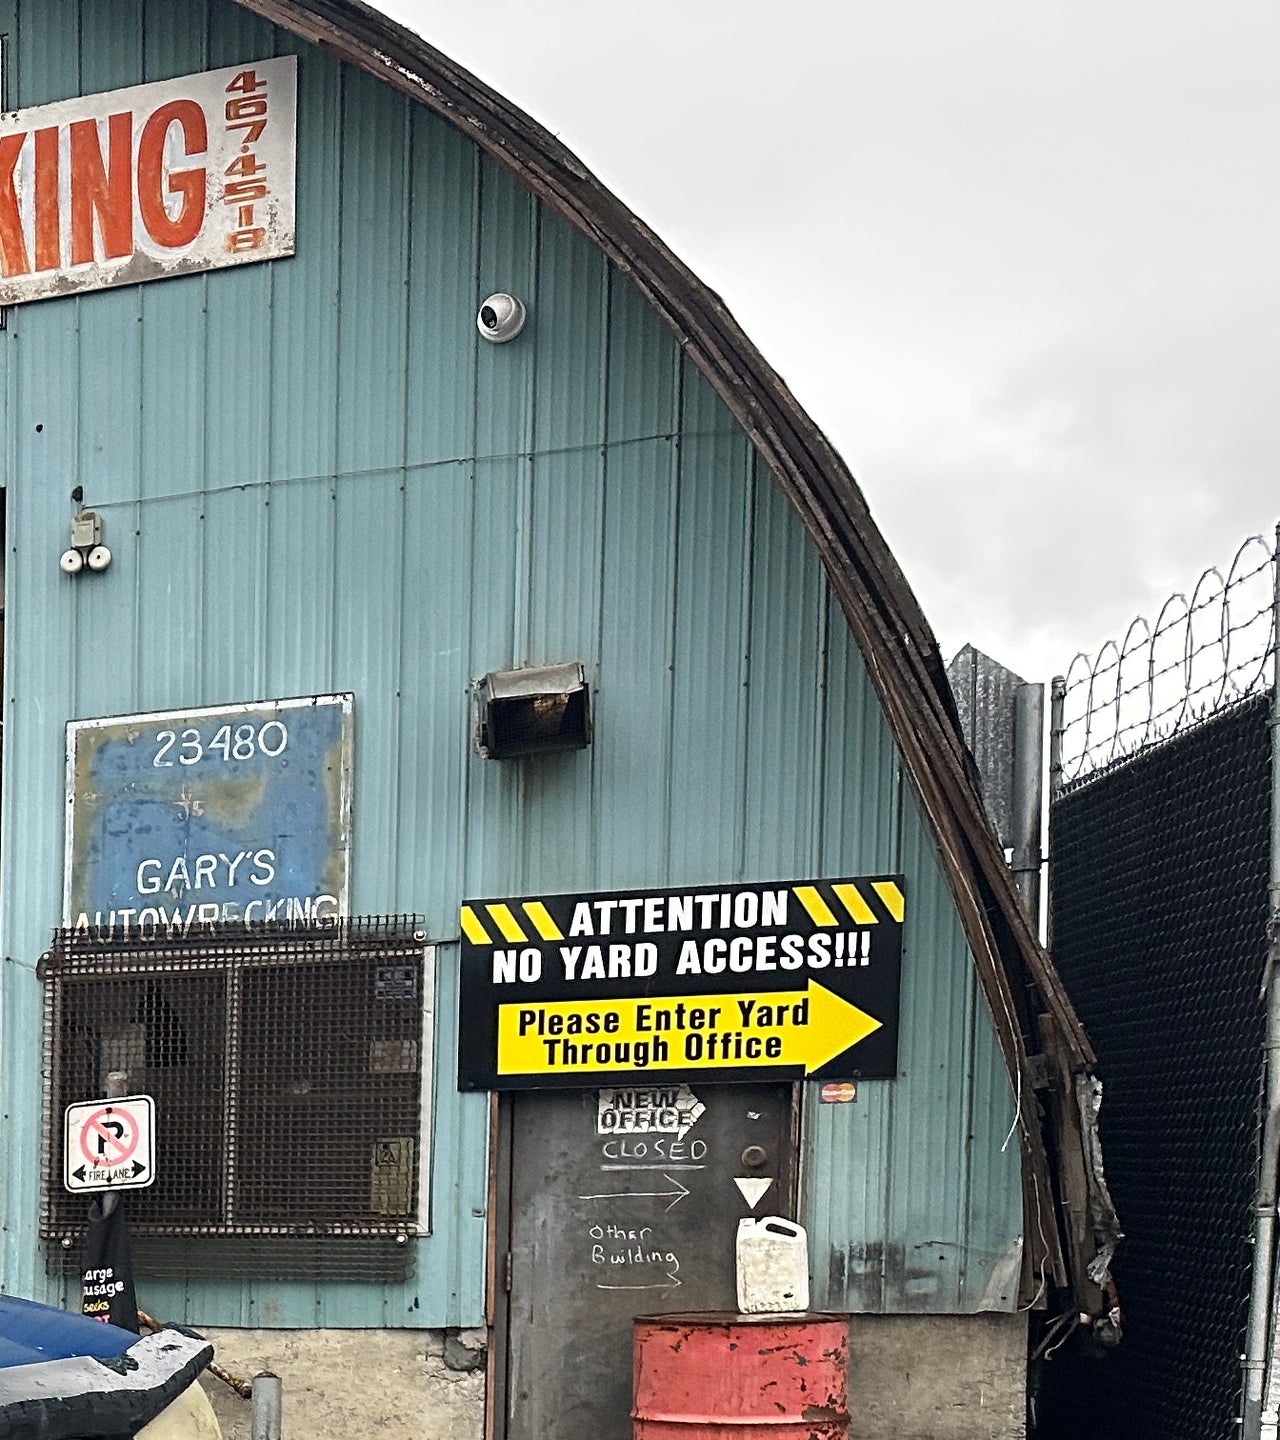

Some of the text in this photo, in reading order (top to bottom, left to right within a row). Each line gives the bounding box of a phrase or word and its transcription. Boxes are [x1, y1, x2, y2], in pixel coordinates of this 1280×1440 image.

[153, 721, 288, 767] 23480
[136, 849, 276, 894] GARY'S
[569, 890, 788, 937] ATTENTION
[492, 931, 871, 984] NO YARD ACCESS!!!
[519, 998, 810, 1036] Please Enter Yard
[543, 1032, 783, 1067] Through Office
[614, 1090, 675, 1109] NEW
[601, 1109, 692, 1129] OFFICE
[603, 1139, 707, 1160] CLOSED
[88, 1168, 131, 1182] FIRE LANE
[84, 1267, 113, 1283] arge
[592, 1244, 680, 1275] Building
